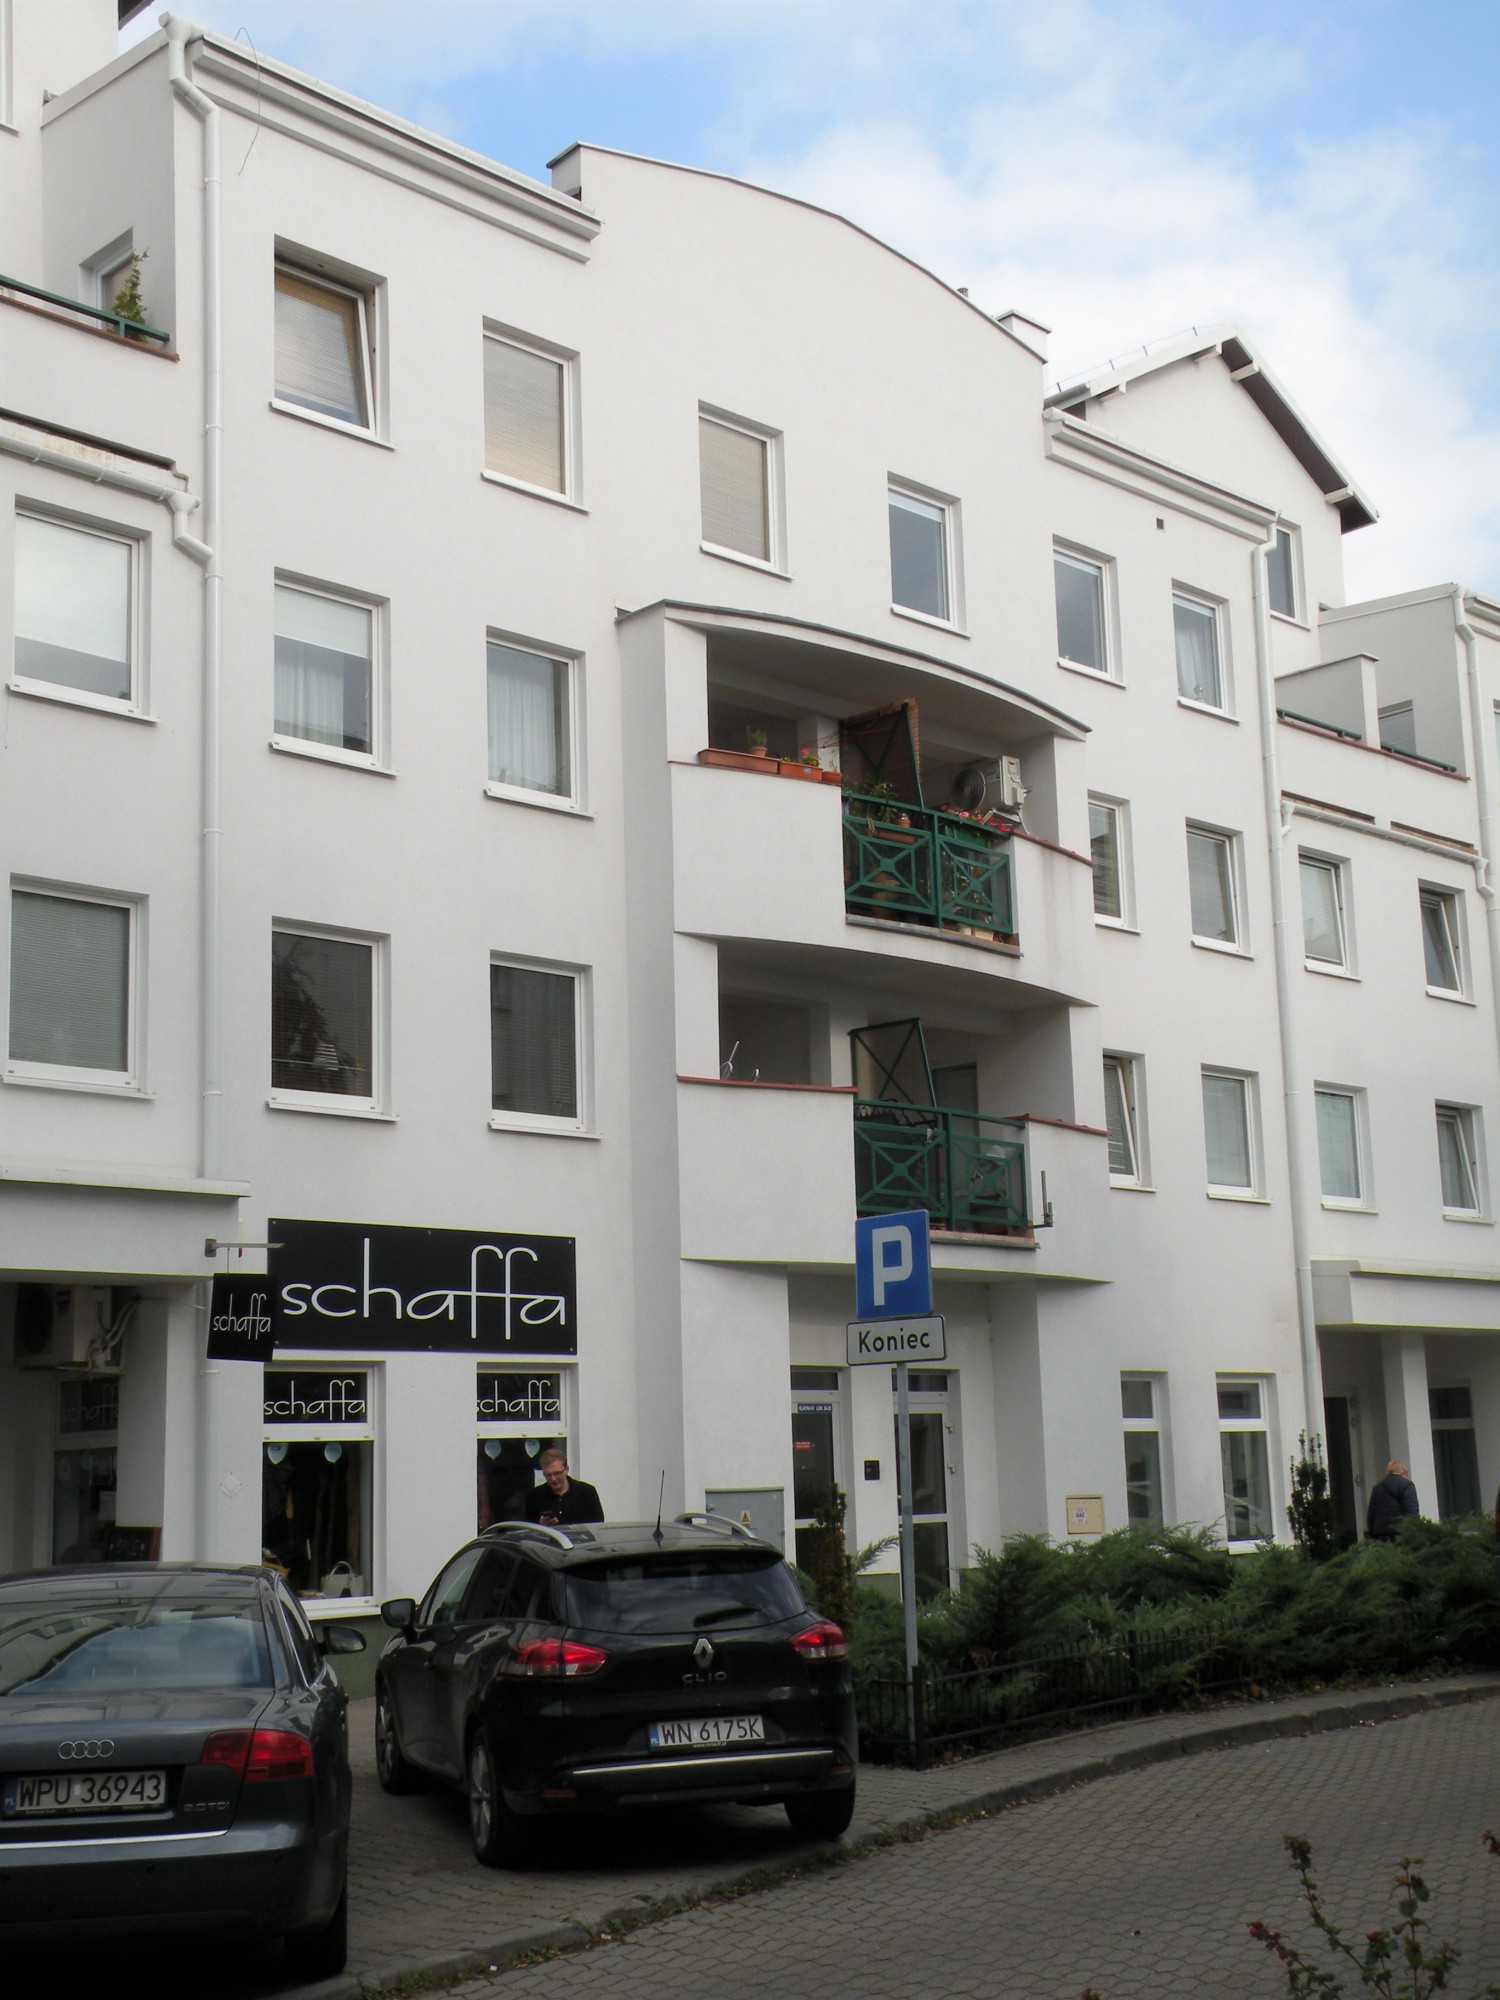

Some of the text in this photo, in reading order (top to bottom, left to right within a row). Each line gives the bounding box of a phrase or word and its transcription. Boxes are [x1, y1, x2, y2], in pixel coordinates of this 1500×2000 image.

[872, 1225, 913, 1306] P
[281, 1236, 566, 1341] schaffa
[212, 1292, 272, 1341] schaffa
[858, 1327, 931, 1354] Koniec
[263, 1379, 366, 1421] schaffa
[682, 1671, 727, 1684] CLIO
[661, 1717, 761, 1744] WN 6175K
[19, 1774, 162, 1807] WPU 36943
